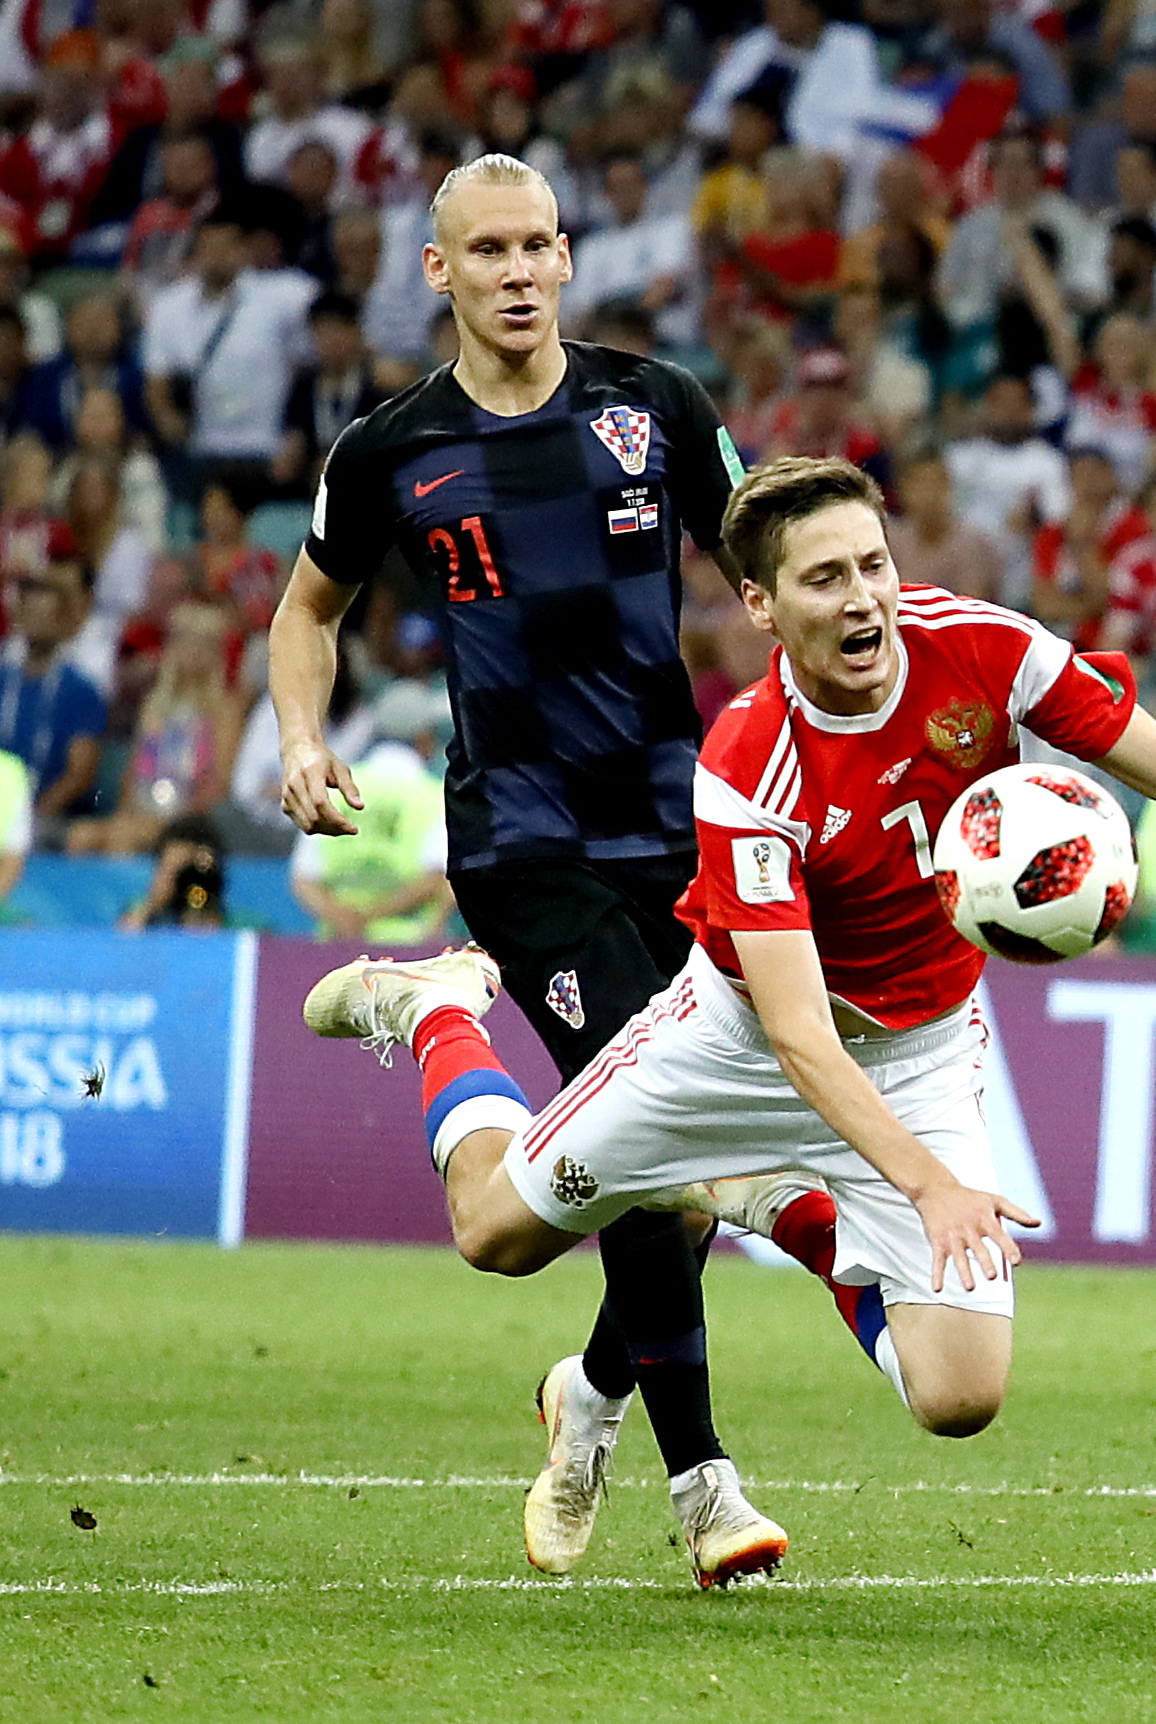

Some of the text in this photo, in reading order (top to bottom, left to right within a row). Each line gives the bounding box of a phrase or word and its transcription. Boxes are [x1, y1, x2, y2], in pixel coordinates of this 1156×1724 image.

[427, 516, 504, 602] 21
[880, 799, 935, 879] 7
[0, 1033, 167, 1112] SSIA
